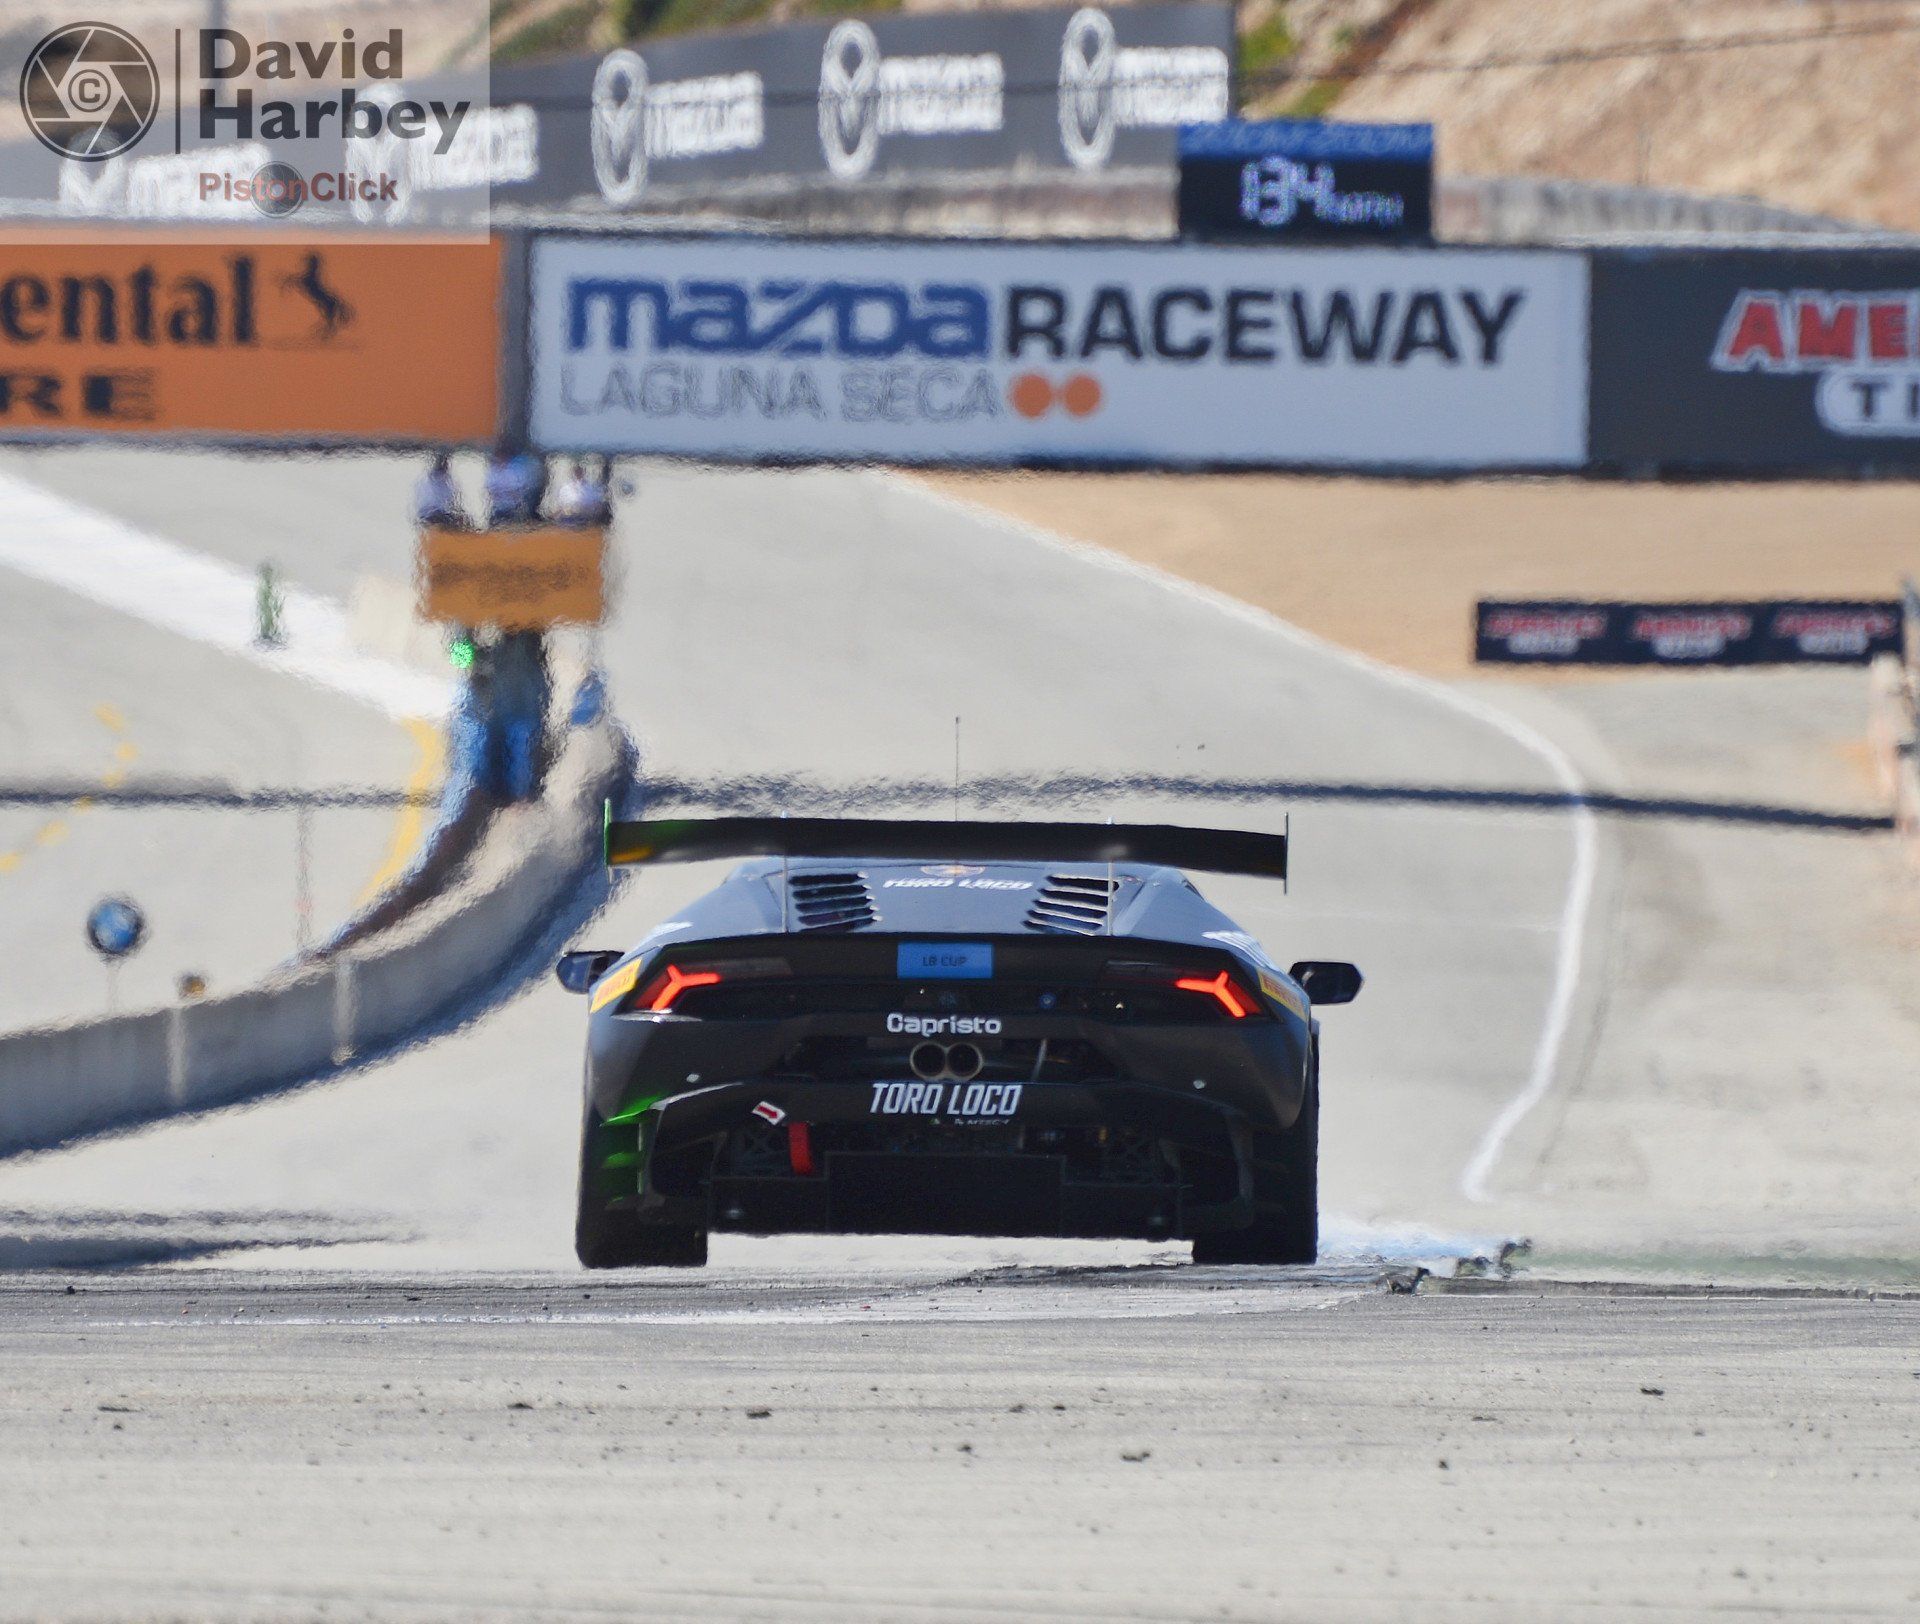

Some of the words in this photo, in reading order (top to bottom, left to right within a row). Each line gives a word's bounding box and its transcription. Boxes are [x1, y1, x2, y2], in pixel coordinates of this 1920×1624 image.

[565, 278, 990, 358] mazda
[1005, 283, 1525, 366] RACEWAY
[559, 361, 828, 419] LAGUNA
[838, 363, 999, 422] SECA
[886, 1012, 1002, 1037] Capristo
[869, 1082, 944, 1115] TORO
[946, 1083, 1024, 1116] LOCO
